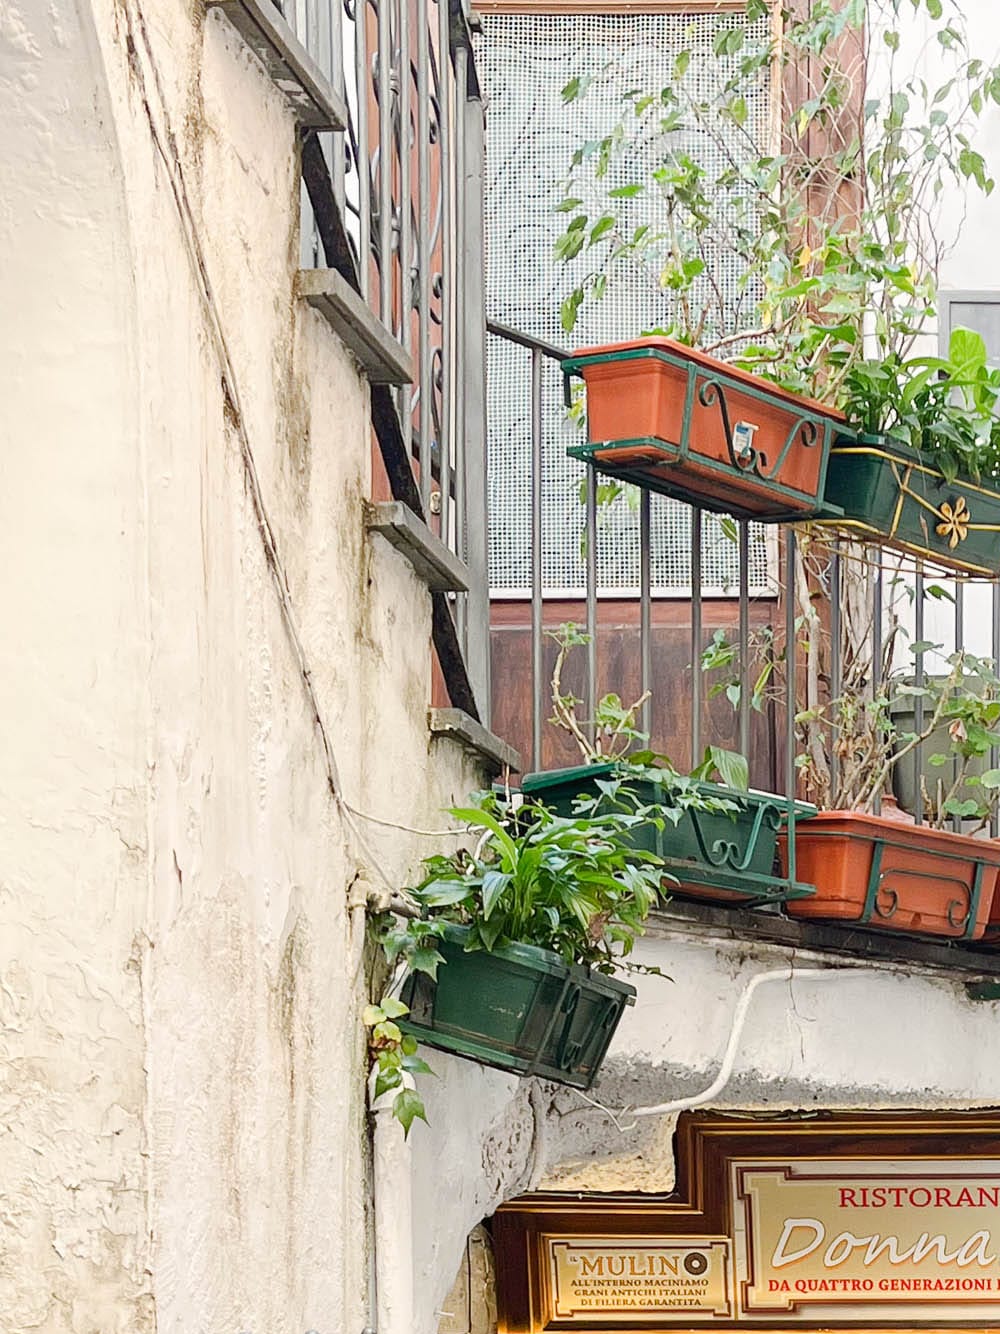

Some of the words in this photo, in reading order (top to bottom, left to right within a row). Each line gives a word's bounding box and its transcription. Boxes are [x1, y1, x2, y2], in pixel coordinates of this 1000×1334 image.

[771, 1217, 997, 1268] Donna
[645, 1279, 709, 1287] MACINIAMO
[768, 1279, 790, 1291] DA
[795, 1279, 874, 1293] QUATTRO
[879, 1278, 992, 1291] GENERAZIONI
